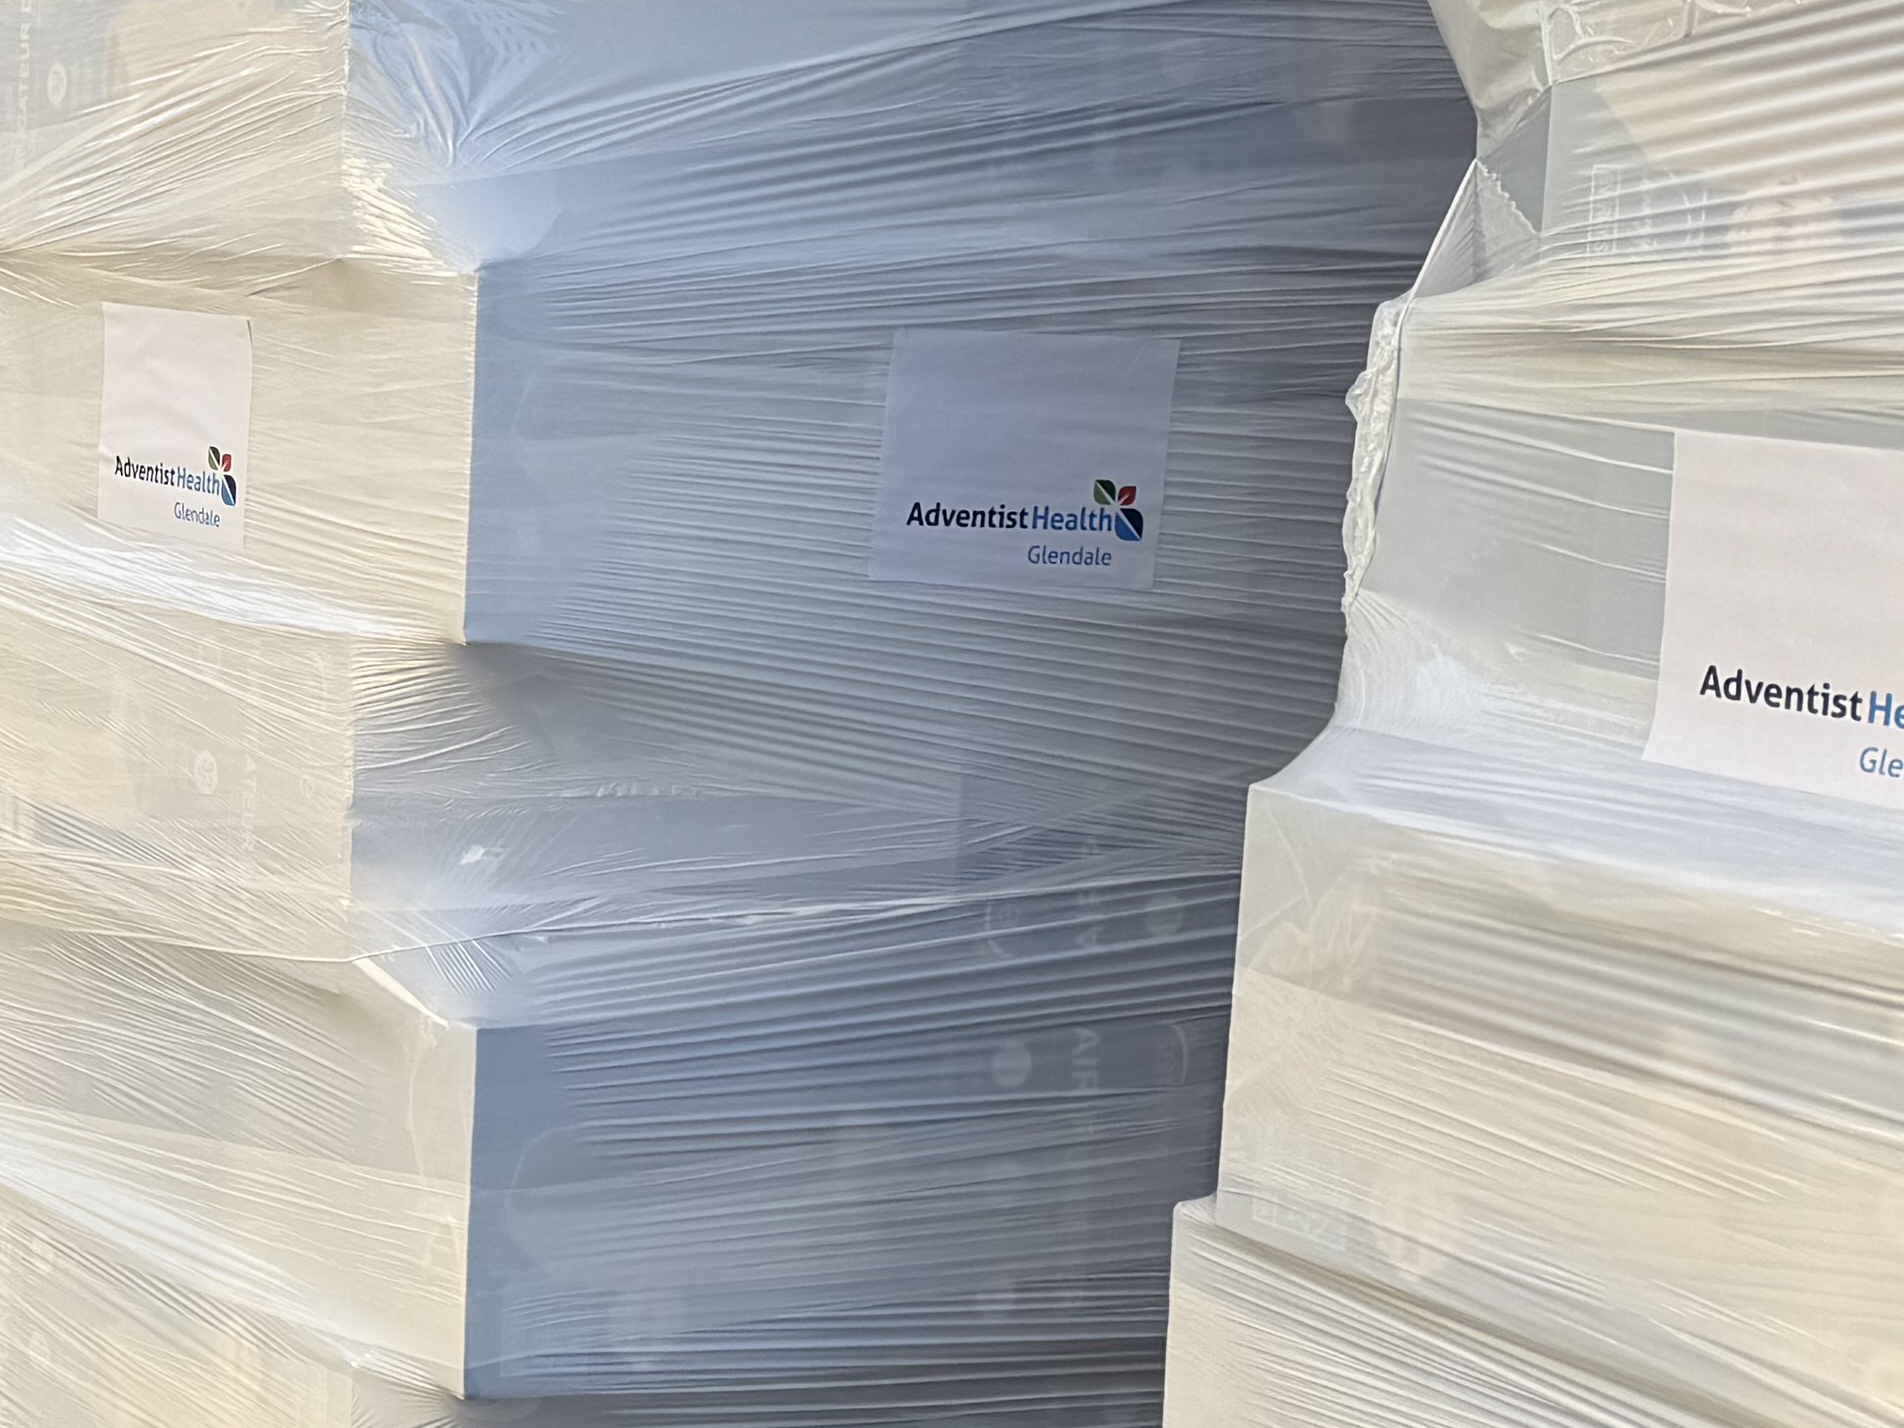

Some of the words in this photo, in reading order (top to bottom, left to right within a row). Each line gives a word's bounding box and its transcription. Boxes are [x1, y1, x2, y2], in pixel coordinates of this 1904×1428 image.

[114, 455, 175, 486] Adventist
[177, 465, 220, 496] Health
[174, 501, 220, 528] Glendale
[906, 502, 1028, 529] Adventist
[1032, 505, 1113, 532] Health
[1027, 545, 1112, 567] Glendale
[1699, 664, 1863, 723] Adventist
